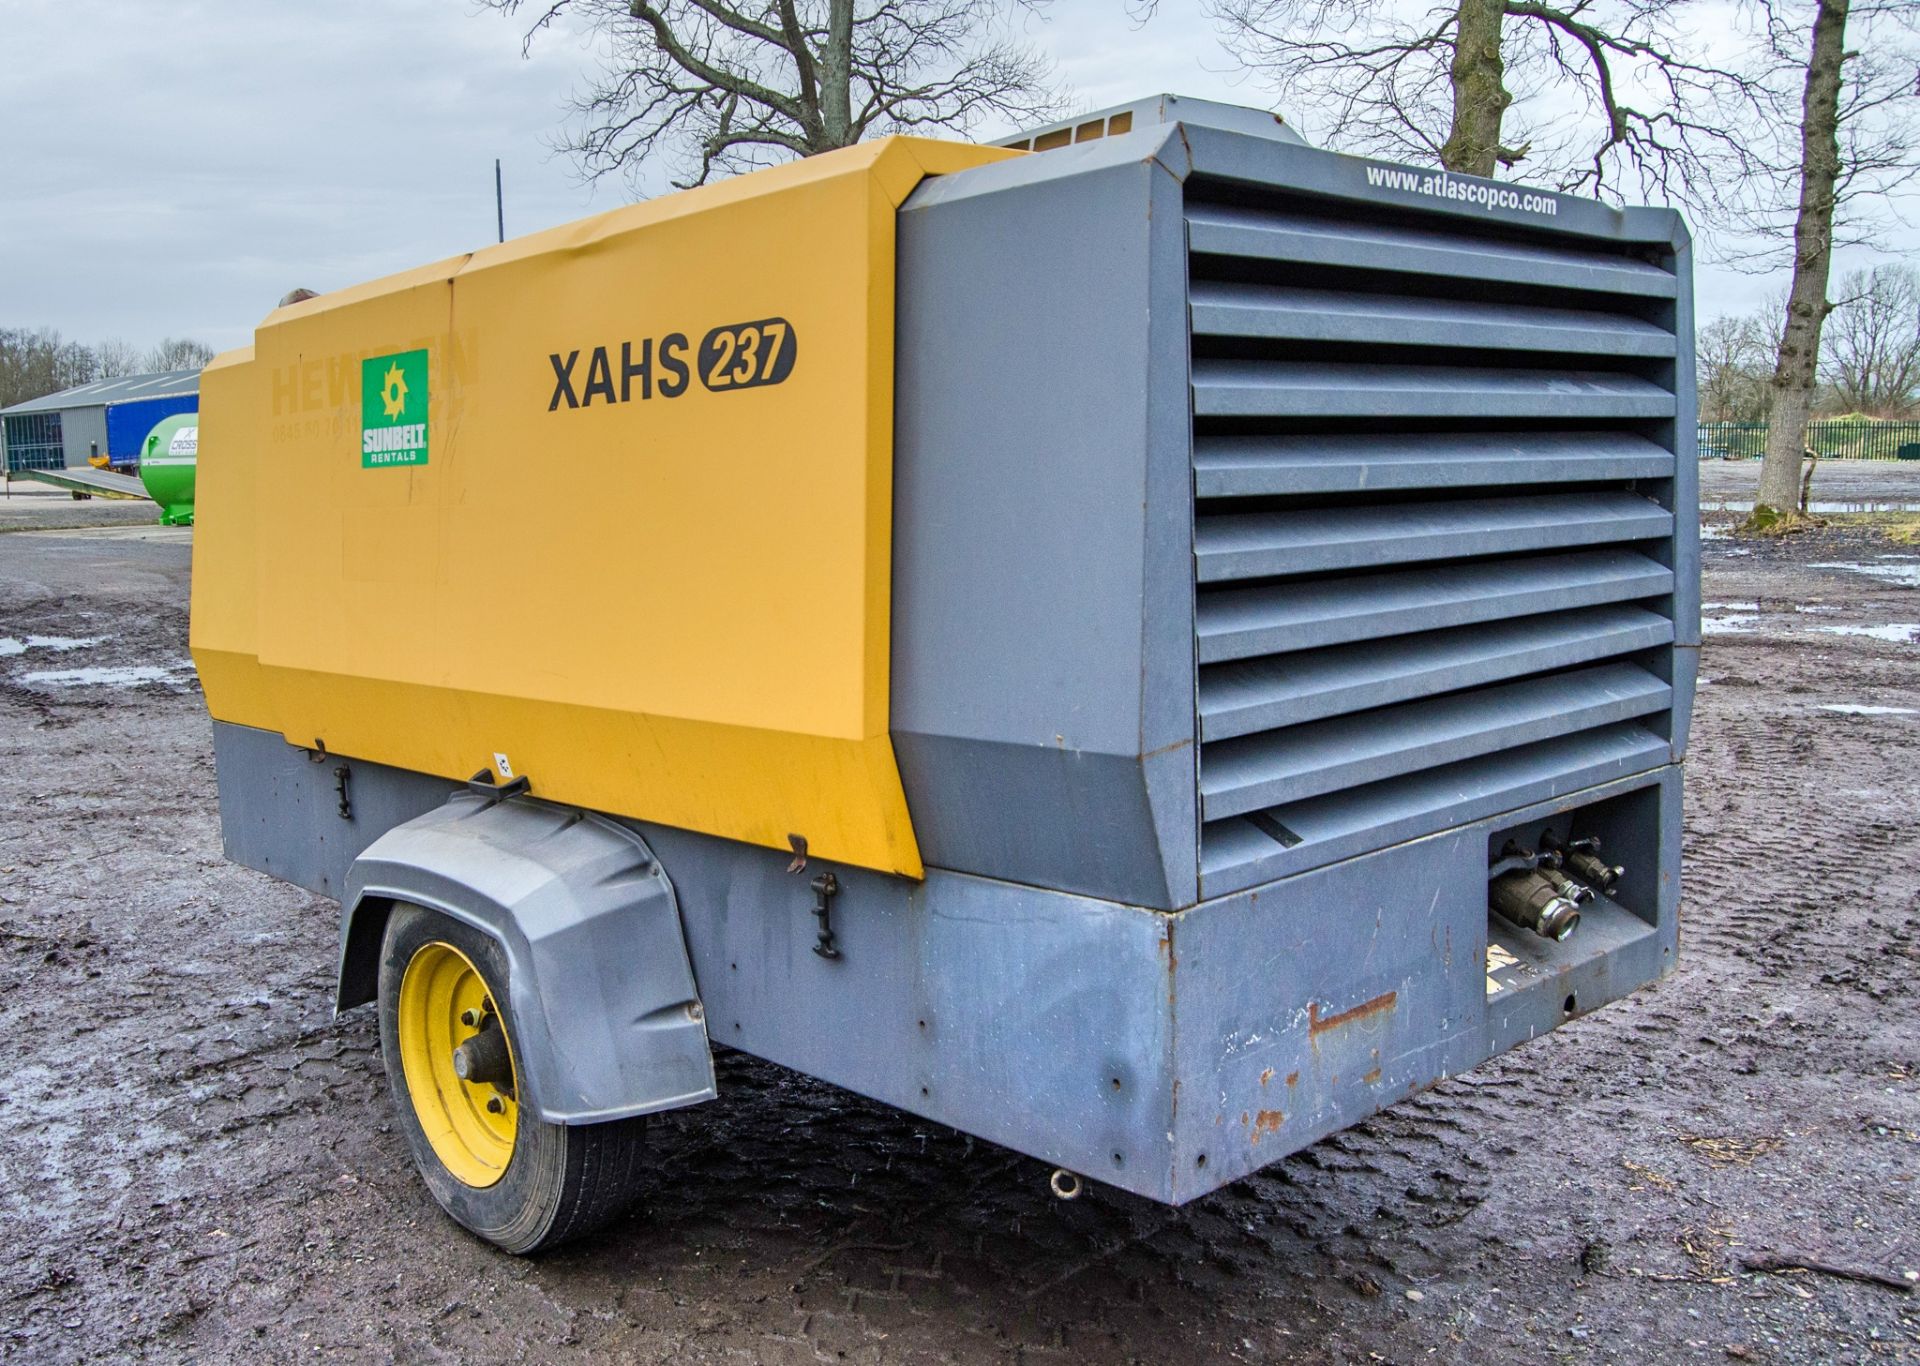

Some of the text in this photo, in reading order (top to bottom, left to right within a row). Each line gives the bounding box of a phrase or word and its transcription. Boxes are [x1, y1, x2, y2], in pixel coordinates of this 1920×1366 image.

[1366, 166, 1557, 215] www.atlascopco.com
[548, 323, 786, 412] XAHS 237
[363, 423, 426, 453] SUNBELT
[371, 451, 416, 463] RENTALS
